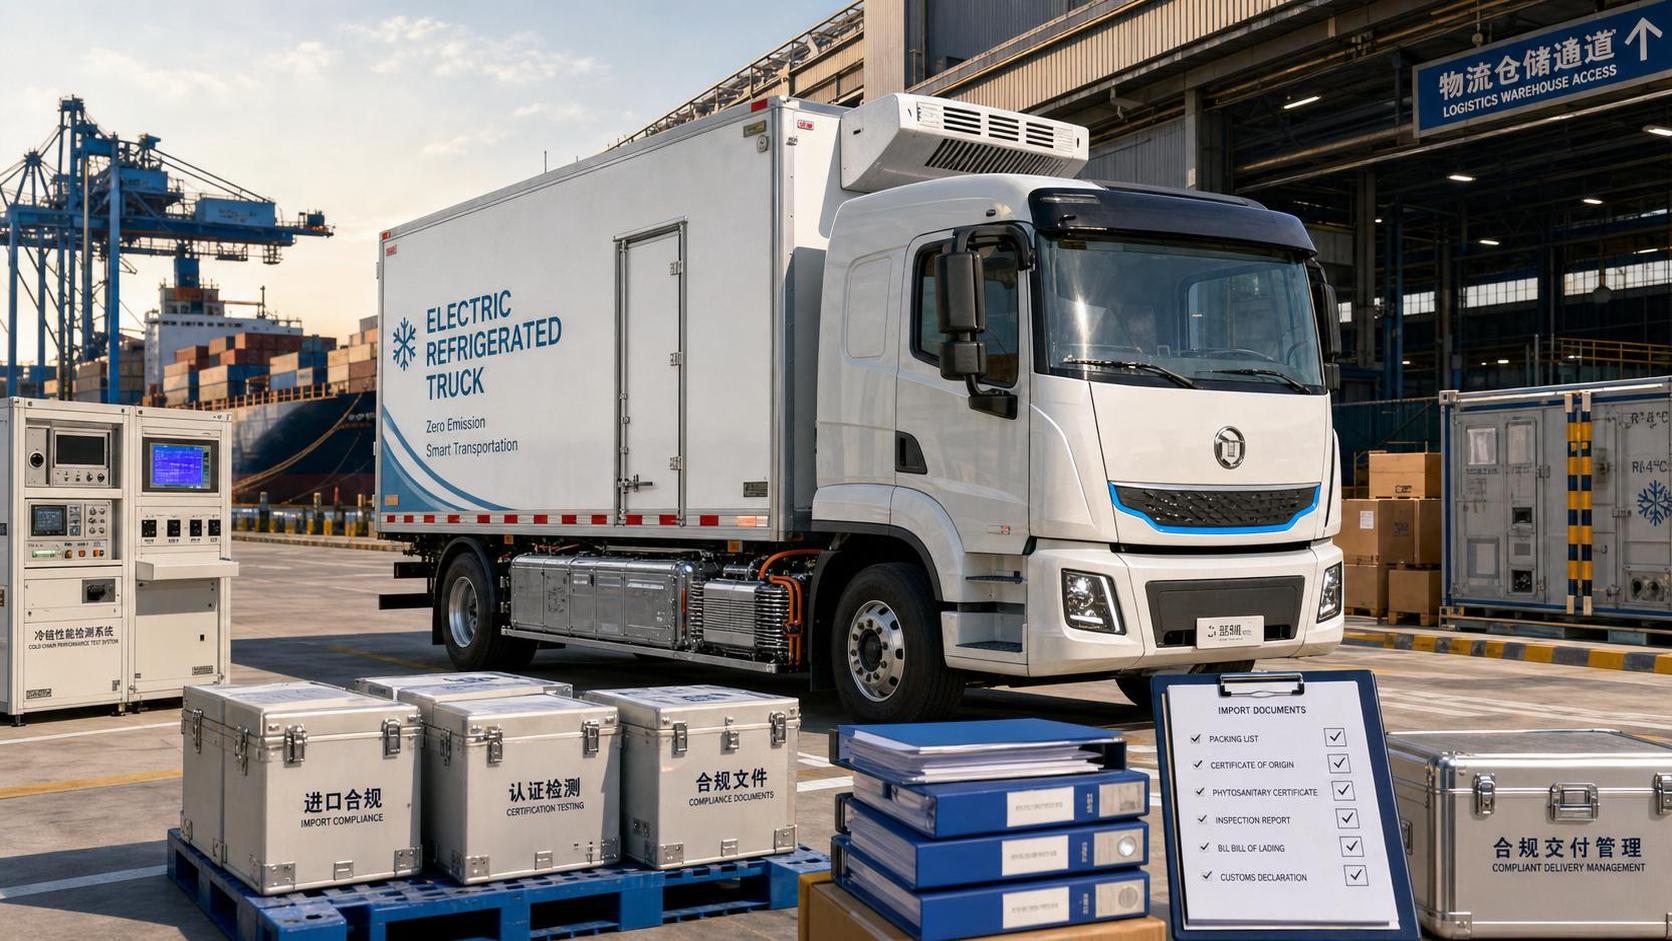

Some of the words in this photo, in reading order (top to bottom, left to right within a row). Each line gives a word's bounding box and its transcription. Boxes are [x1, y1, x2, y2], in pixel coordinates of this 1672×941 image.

[1439, 29, 1617, 100] 物流仓储通道
[1443, 94, 1498, 117] LOGISTICS
[1500, 76, 1569, 103] WAREHOUSE
[1572, 64, 1617, 86] ACCESS
[426, 289, 512, 334] ELECTRIC
[426, 316, 562, 367] REFRIGERATED
[426, 367, 485, 401] TRUCK
[426, 420, 445, 433] Zero
[447, 416, 486, 431] Emission
[426, 443, 451, 457] Smart
[454, 438, 518, 457] Transportation
[1218, 706, 1250, 714] IMPORT
[1253, 705, 1306, 714] DOCUMENTS
[1209, 735, 1242, 743] PACKING
[1210, 761, 1255, 769] CERTIFICATE
[1257, 761, 1267, 769] OF
[695, 767, 767, 793] 合规文件
[509, 777, 580, 802] 认证检测
[1212, 788, 1271, 797] PHYTOSANITARY
[1272, 788, 1319, 797] CERTIFICATE
[304, 788, 382, 813] 进口合规
[688, 795, 732, 806] COMPLIANCE
[733, 791, 775, 802] DOCUMENTS
[506, 804, 556, 816] CERTIFICATION
[557, 801, 584, 811] TESTING
[300, 817, 331, 828] IMPORT
[332, 813, 384, 826] COMPLIANCE
[1215, 816, 1260, 824] INSPECTION
[1261, 816, 1290, 824] REPORT
[1231, 844, 1246, 852] BILL
[1247, 844, 1257, 852] OF
[1258, 844, 1285, 852] LADING
[1493, 836, 1642, 858] 合规交付管理
[1492, 863, 1541, 872] COMPLIANT
[1544, 863, 1584, 872] DELIVERY
[1586, 863, 1646, 872] MANAGEMENT
[1220, 873, 1256, 881] CUSTOMS
[1257, 873, 1308, 882] DECLARATION
